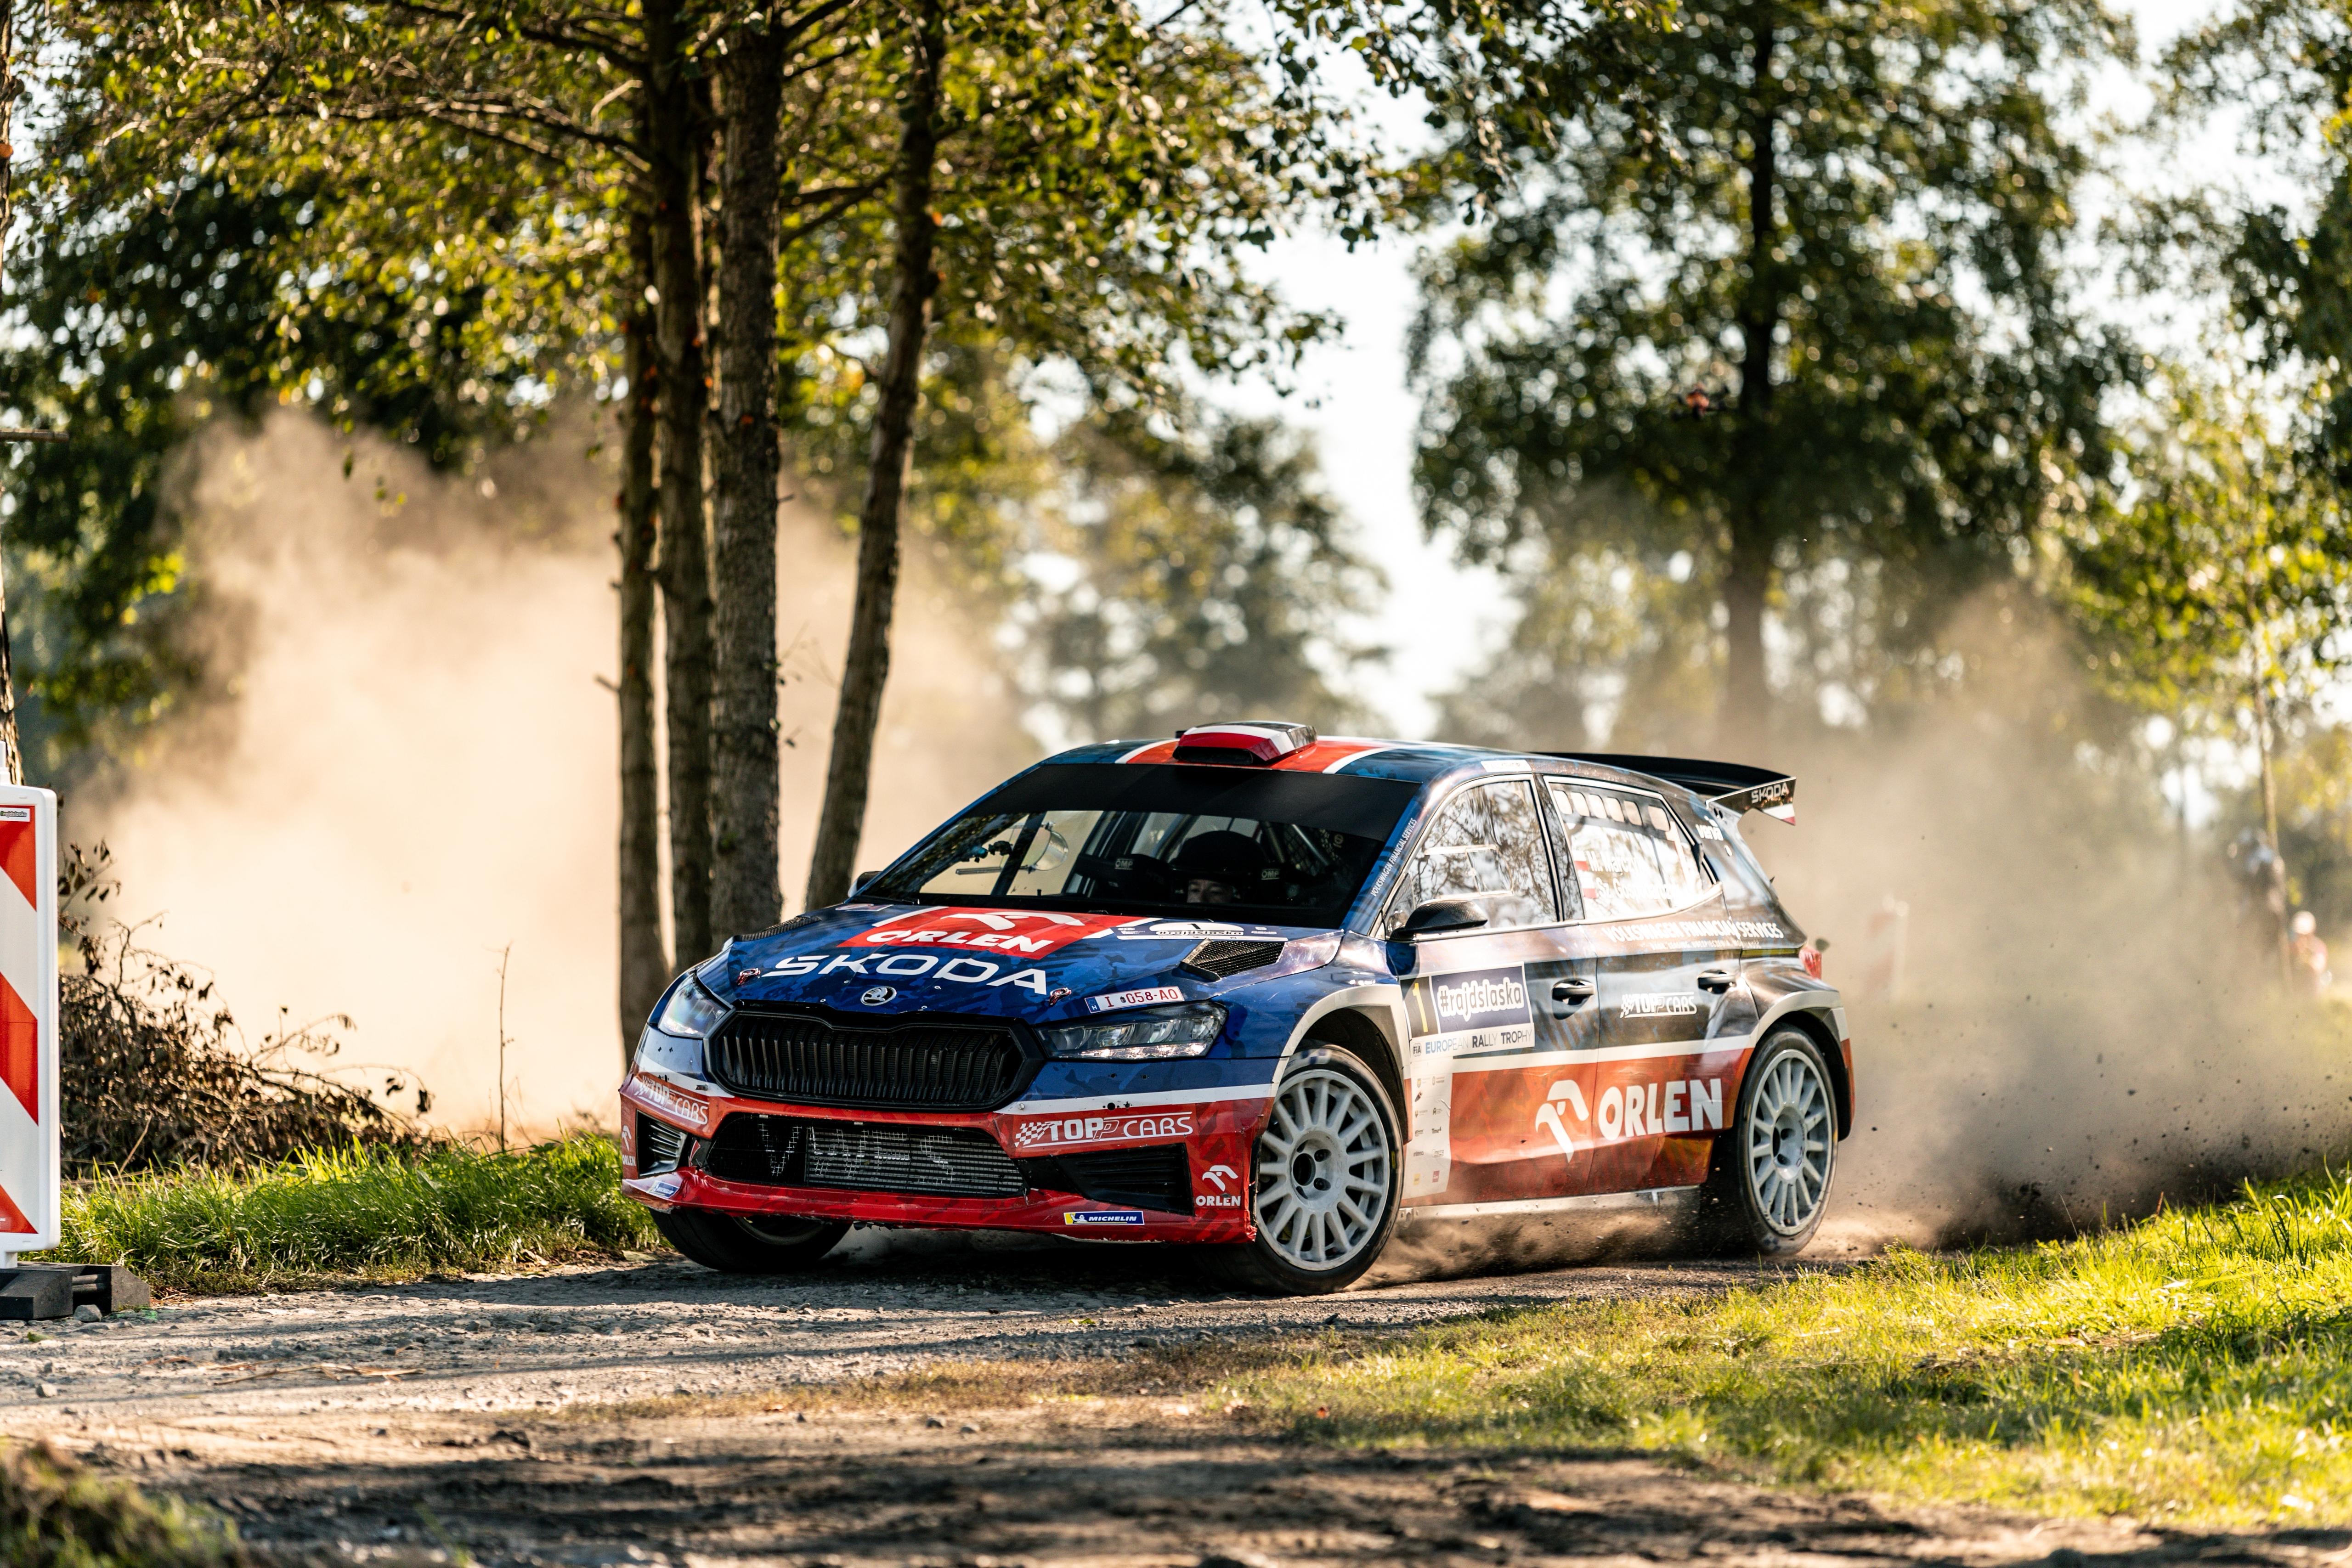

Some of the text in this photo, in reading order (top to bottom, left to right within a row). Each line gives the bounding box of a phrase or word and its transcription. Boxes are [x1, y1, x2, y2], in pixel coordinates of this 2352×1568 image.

[1115, 859, 1133, 868] OMP
[1370, 818, 1417, 897] VOLKSWAGEN FINANCIAL SERVICES
[1261, 870, 1279, 879] OMP
[867, 930, 1054, 953] ORLEN
[1601, 920, 1784, 942] VOLKSWAGEN FINANCIAL SERVICES
[762, 953, 1047, 995] SKODA
[1105, 996, 1114, 1007] I
[1412, 983, 1428, 1032] 1
[1440, 981, 1521, 1015] #rajdslaska
[1666, 996, 1697, 1014] CARS
[1425, 1038, 1469, 1054] EUROPEAN
[1472, 1033, 1498, 1048] RALLY
[1501, 1029, 1532, 1044] TROPHY
[675, 1097, 708, 1124] CARS
[1598, 1078, 1723, 1141] ORLEN
[1124, 1117, 1193, 1138] CARS
[622, 1154, 636, 1167] ORLEN
[1196, 1195, 1240, 1206] ORLEN
